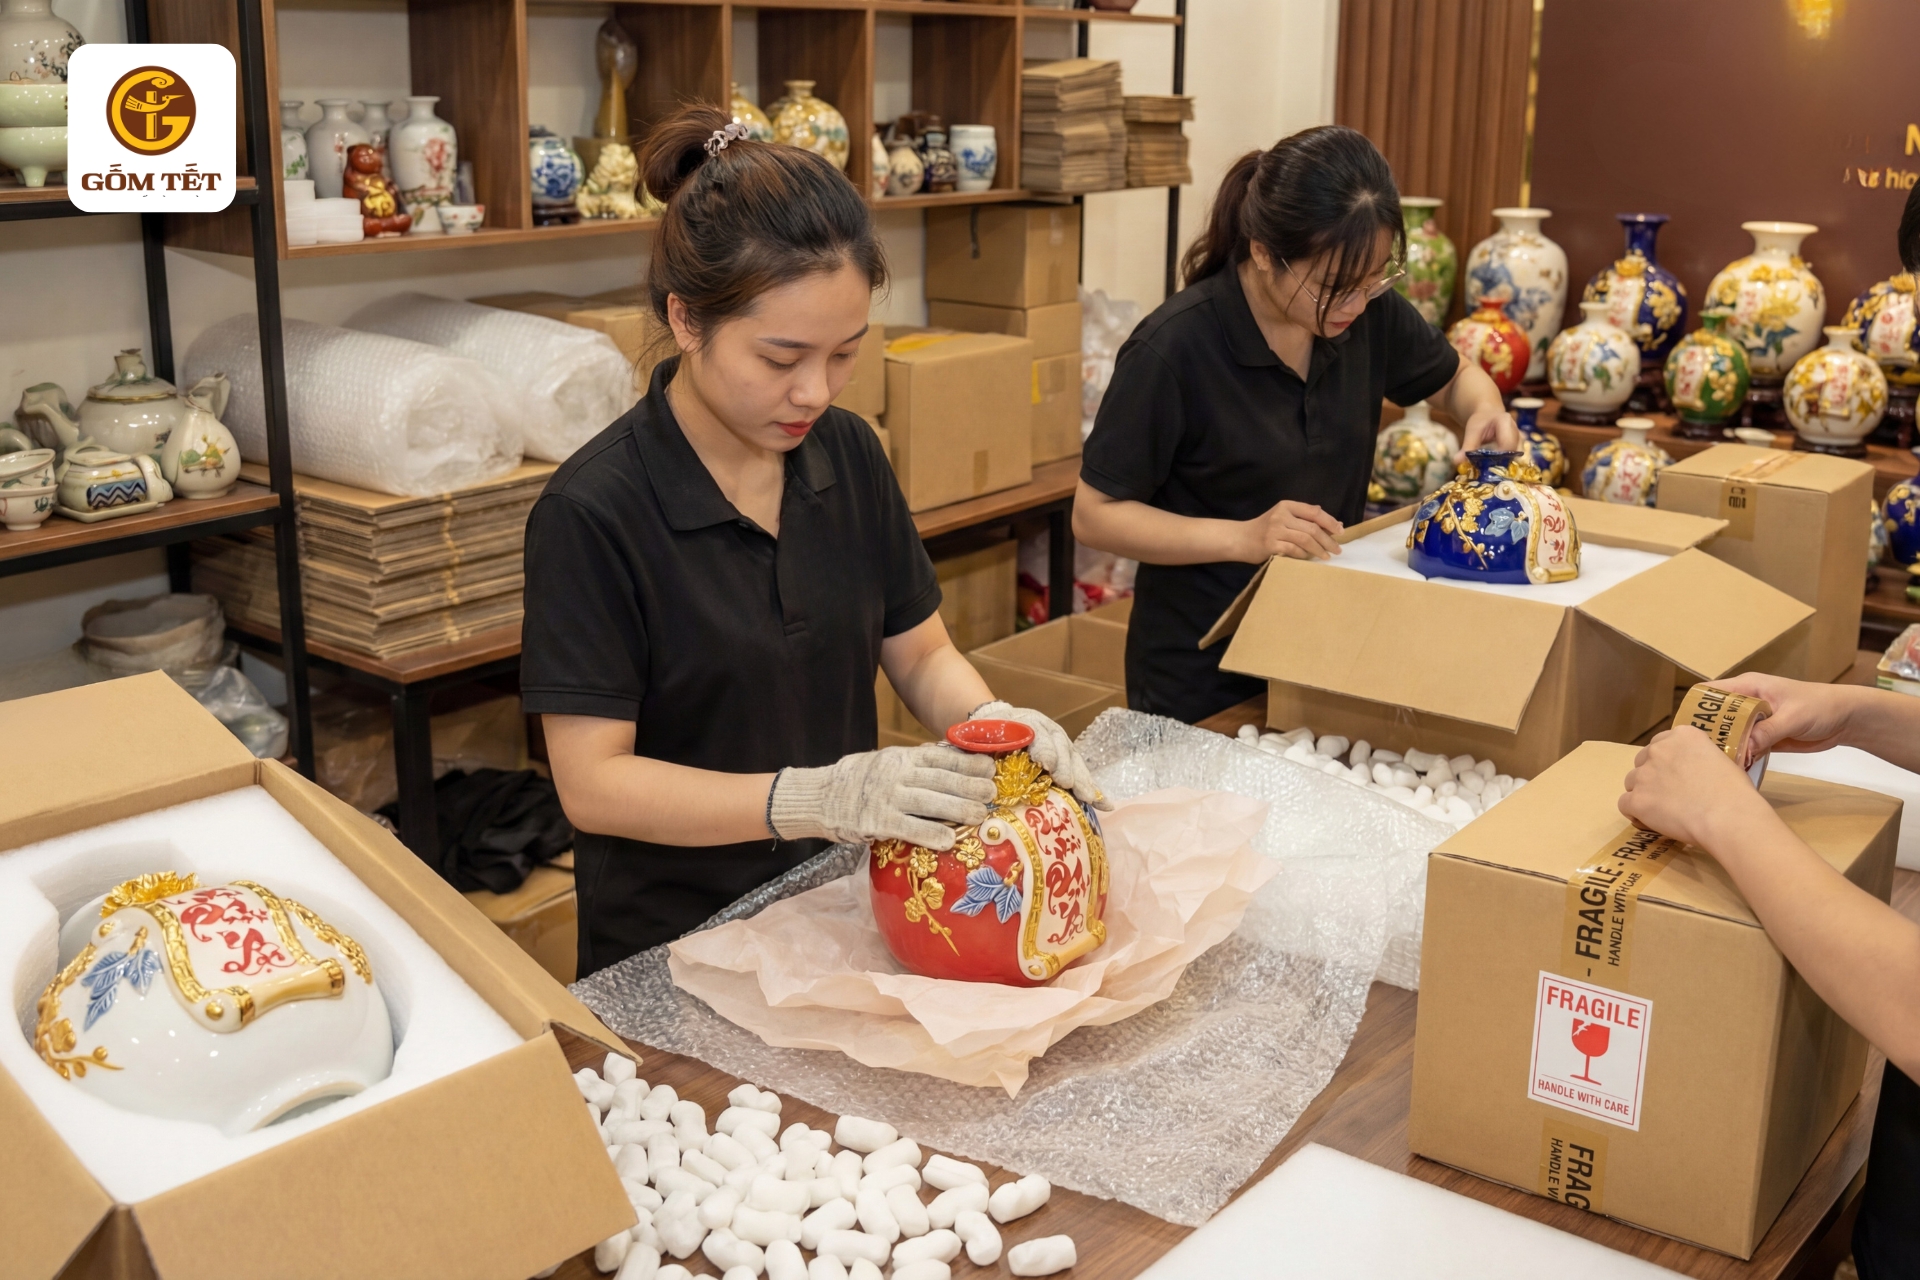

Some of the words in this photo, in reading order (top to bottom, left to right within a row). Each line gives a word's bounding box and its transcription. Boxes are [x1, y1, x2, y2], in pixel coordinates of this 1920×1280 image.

[1575, 866, 1624, 960] FRAGILE
[1608, 916, 1624, 966] HANDLE
[1547, 985, 1640, 1029] FRAGILE
[1538, 1079, 1574, 1099] HANDLE
[1577, 1090, 1602, 1107] WITH
[1604, 1099, 1629, 1116] CARE
[1548, 1137, 1563, 1185] HANDLE
